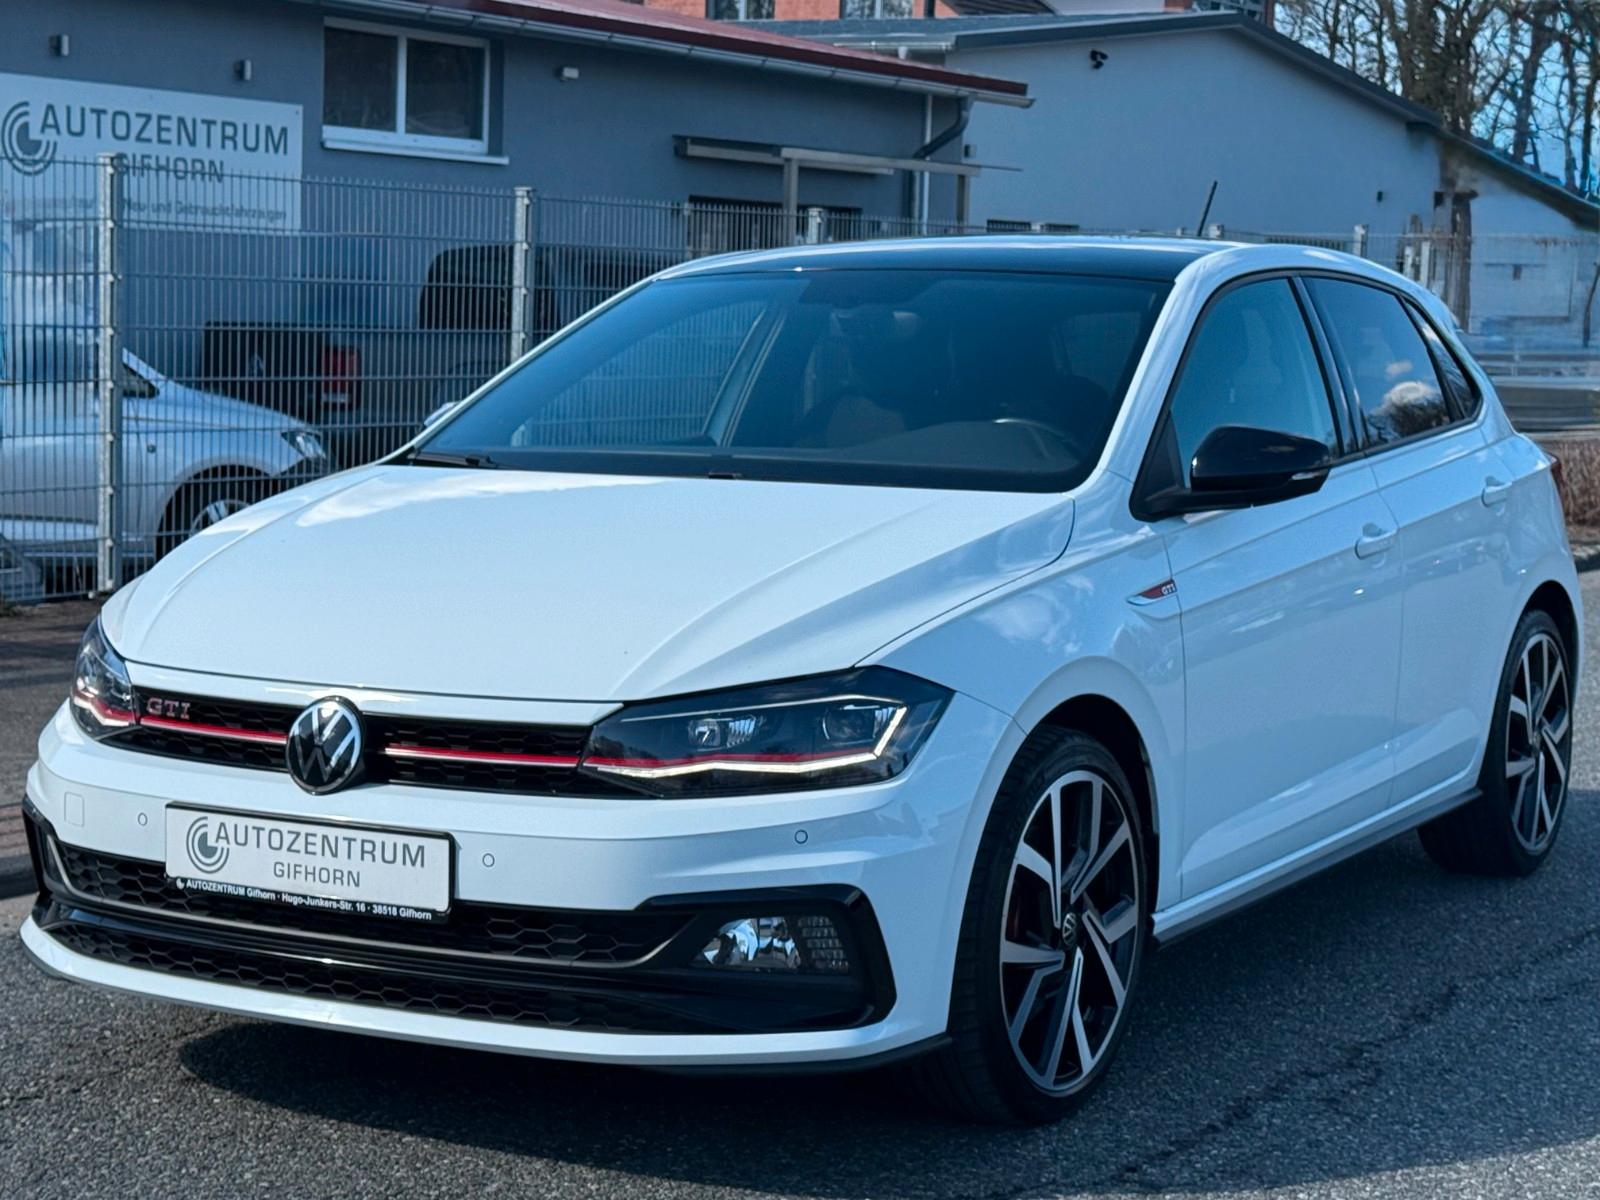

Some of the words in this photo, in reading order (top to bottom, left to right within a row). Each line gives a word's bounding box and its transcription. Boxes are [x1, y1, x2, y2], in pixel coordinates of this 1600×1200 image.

[40, 103, 288, 156] AUTOZENTRUM
[113, 152, 224, 183] GIFHORN
[1161, 583, 1175, 595] GTI
[146, 697, 191, 720] GTI
[215, 821, 426, 868] AUTOZENTRUM
[273, 861, 361, 888] GIFHORN
[186, 879, 246, 896] AUTOZENTRUM
[247, 887, 276, 900] Gifhorn
[356, 902, 366, 912] 16
[372, 904, 398, 916] 38518
[399, 906, 432, 920] Gifhorn
